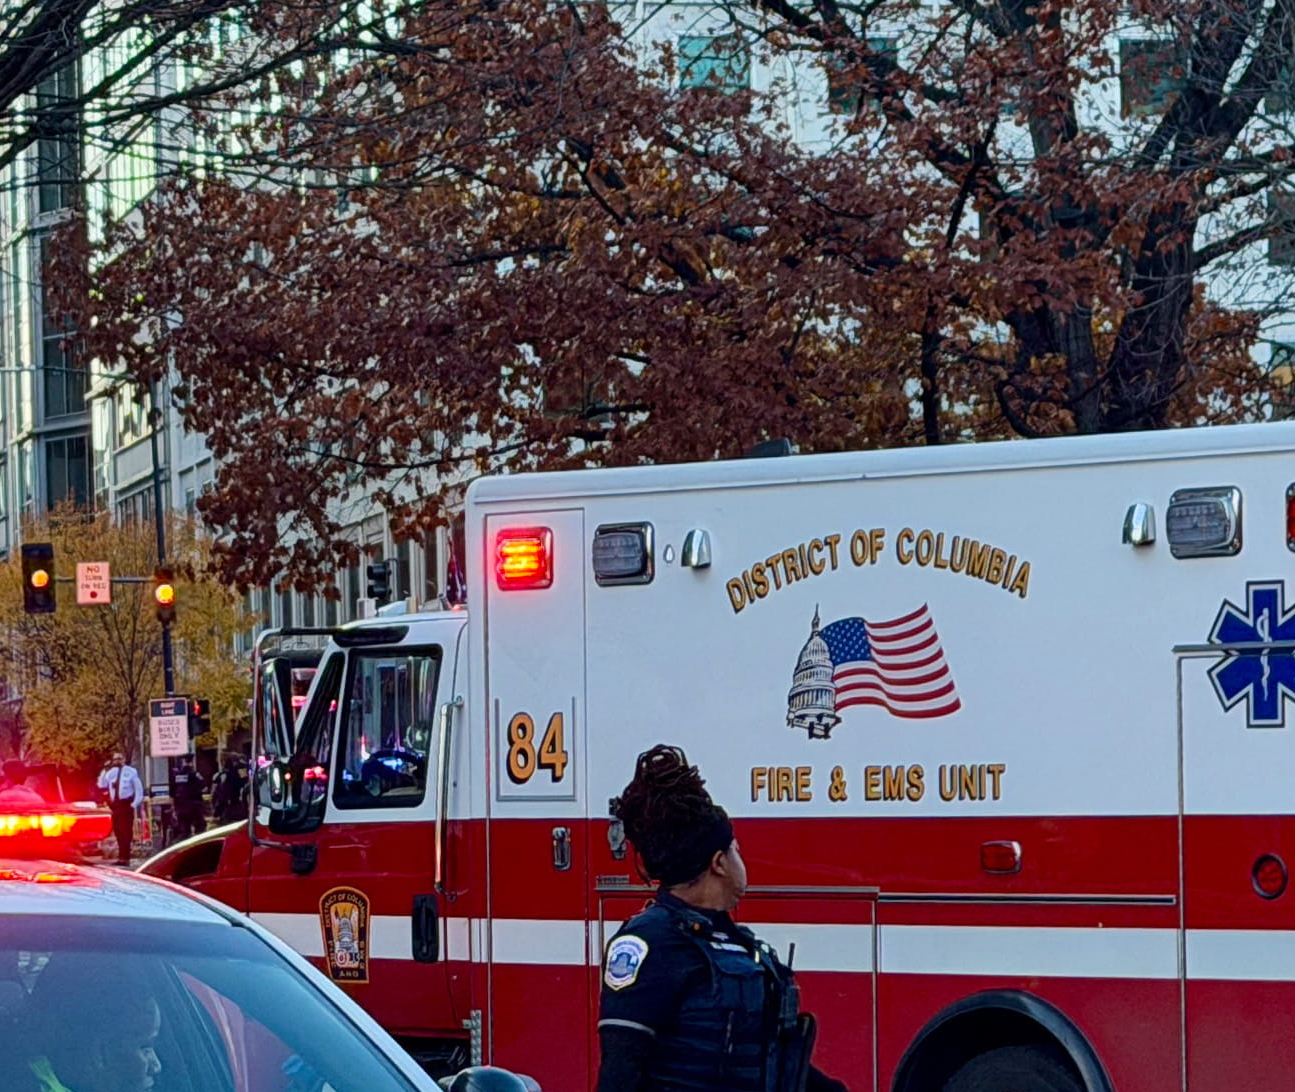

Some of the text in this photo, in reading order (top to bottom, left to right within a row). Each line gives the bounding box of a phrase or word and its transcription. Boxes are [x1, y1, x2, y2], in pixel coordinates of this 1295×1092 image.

[726, 527, 1031, 613] DISTRICT OF COLUMBIA
[506, 711, 569, 785] 84
[750, 763, 1005, 803] FIRE & EMS UNIT
